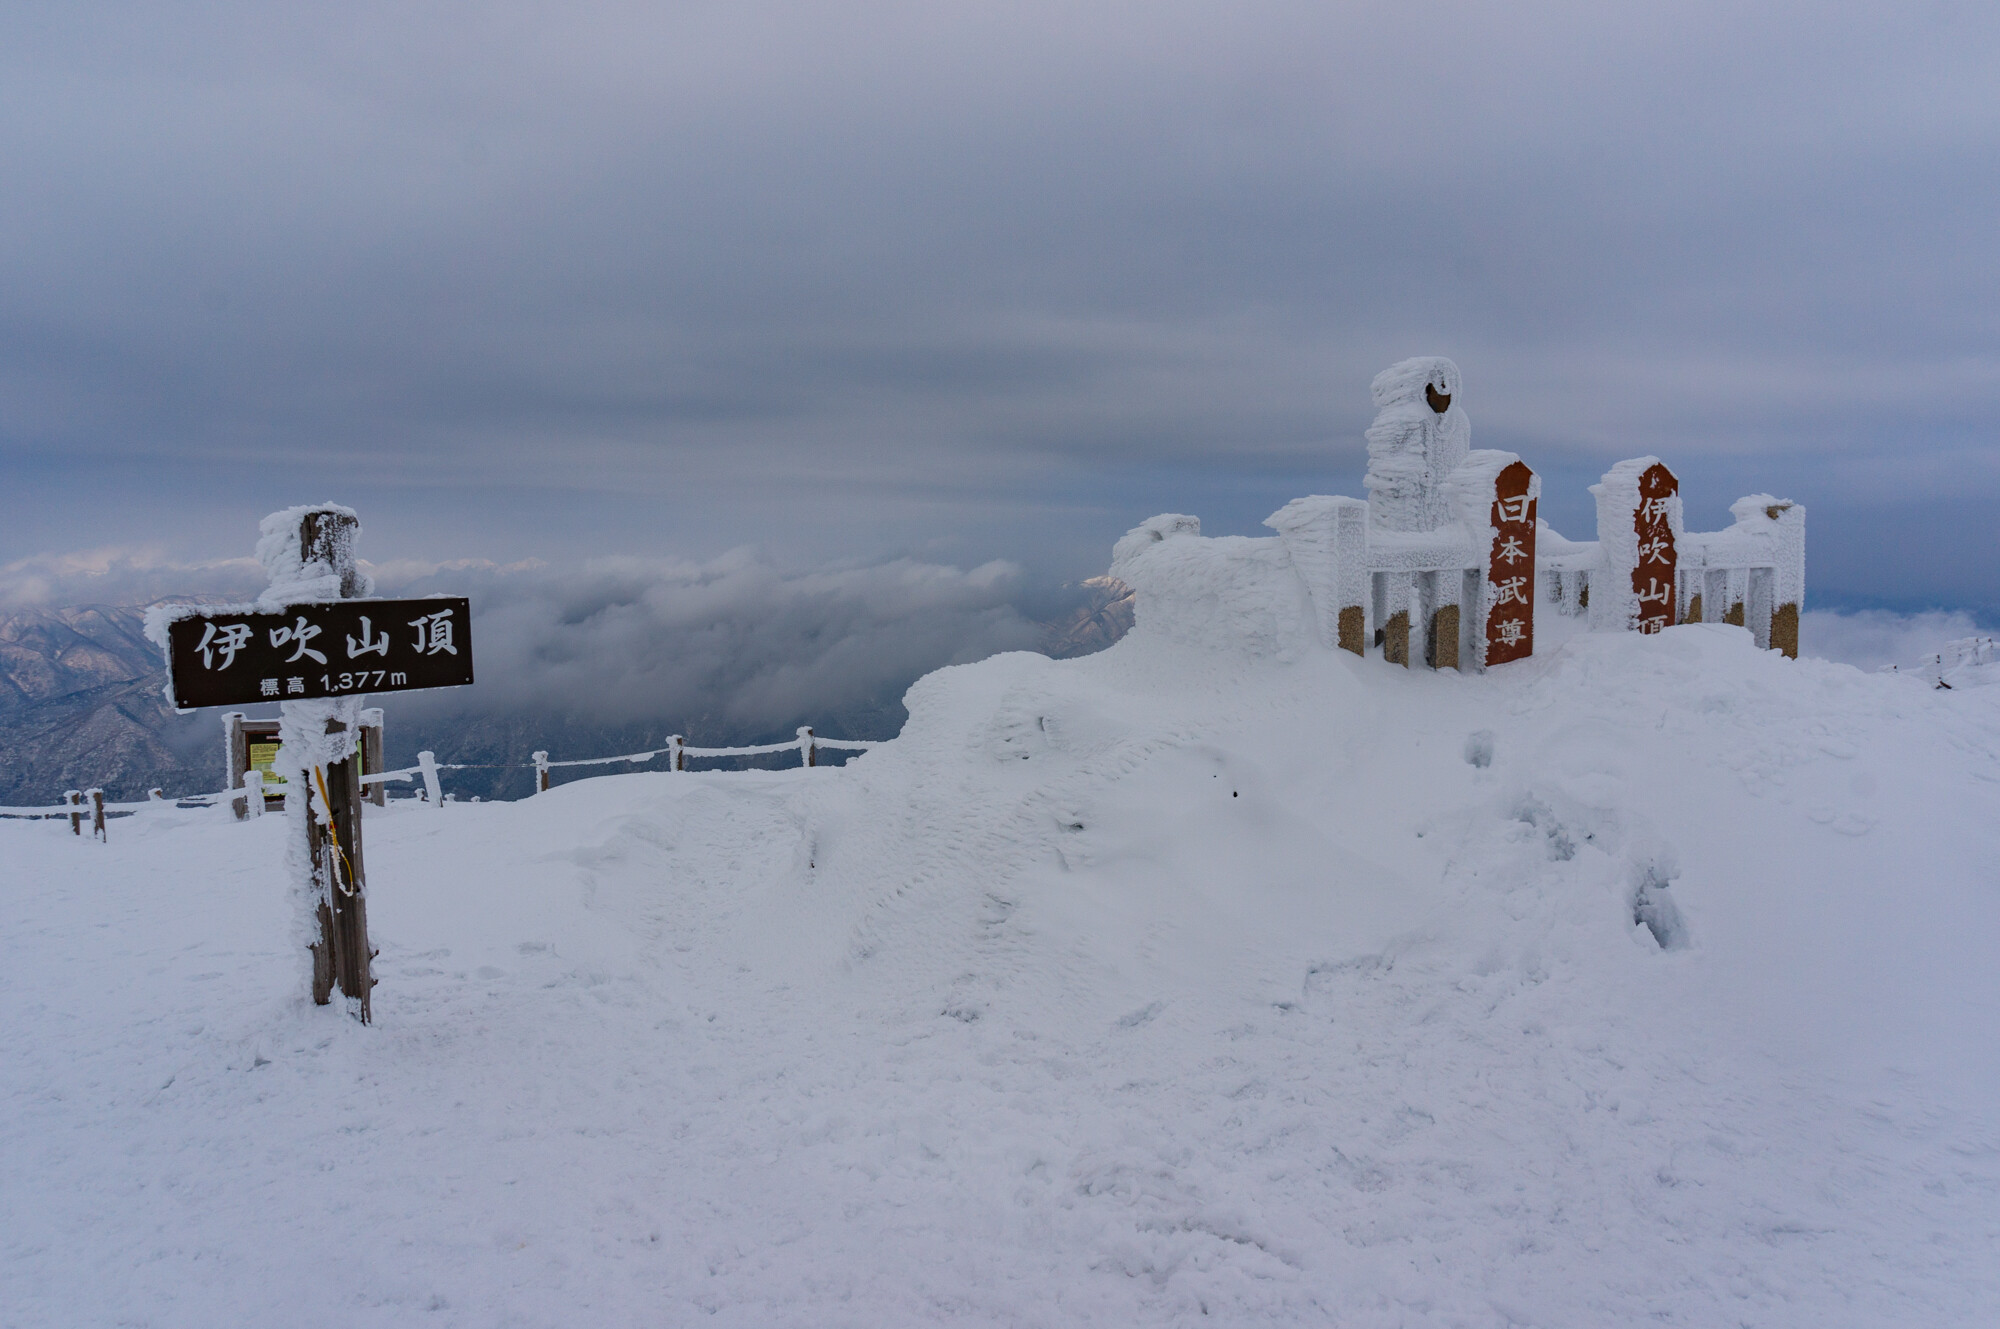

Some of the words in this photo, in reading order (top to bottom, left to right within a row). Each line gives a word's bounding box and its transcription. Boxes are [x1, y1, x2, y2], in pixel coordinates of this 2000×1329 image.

[1495, 494, 1530, 647] 日本武尊
[194, 608, 458, 671] 伊吹山頂
[260, 676, 305, 696] 標高
